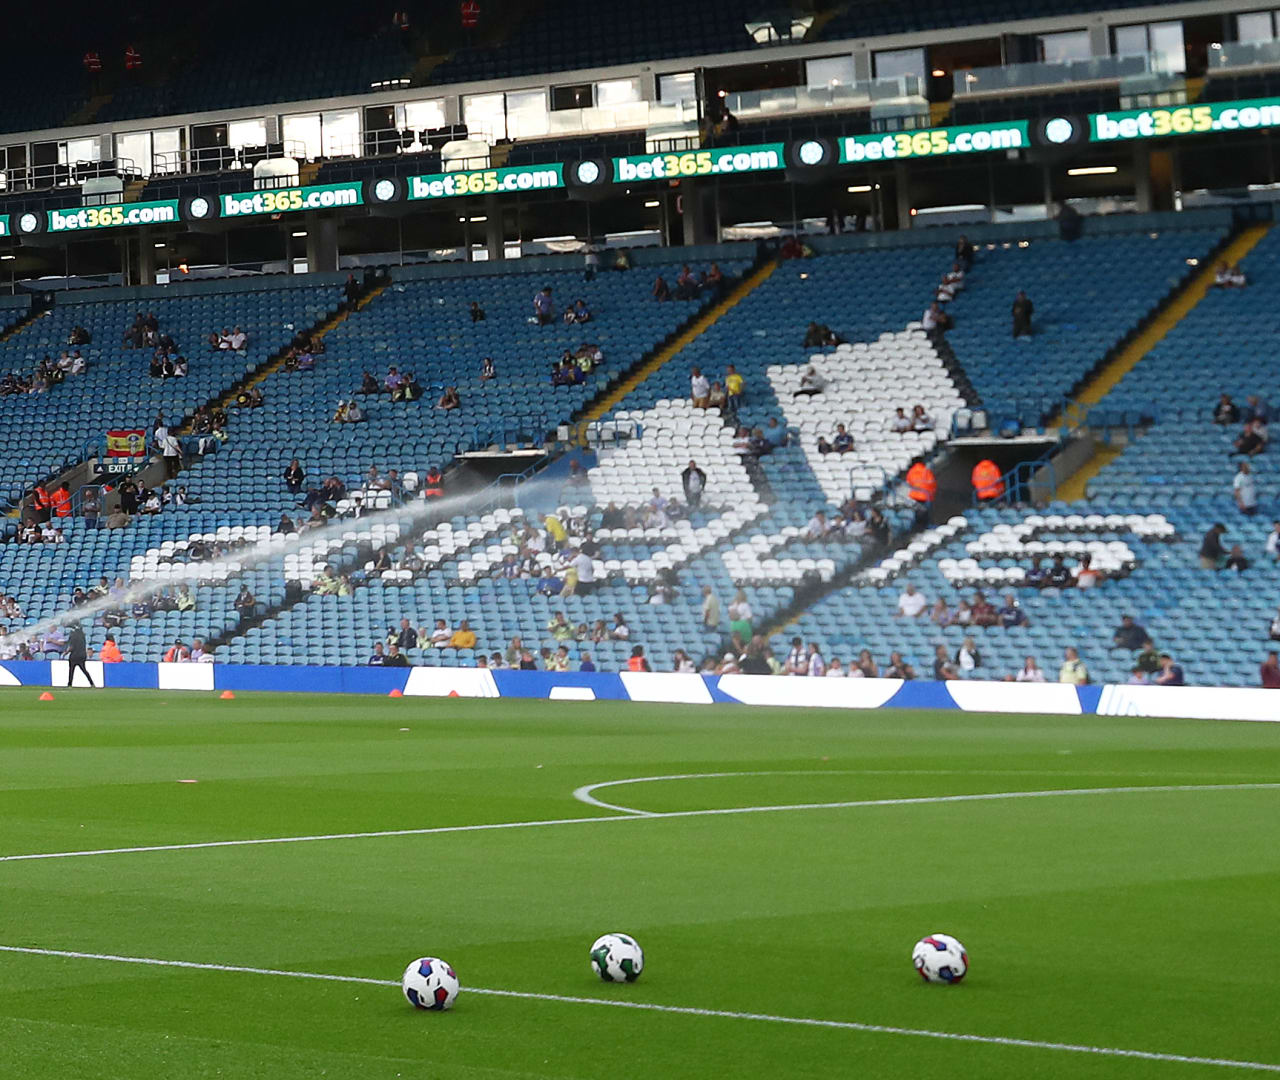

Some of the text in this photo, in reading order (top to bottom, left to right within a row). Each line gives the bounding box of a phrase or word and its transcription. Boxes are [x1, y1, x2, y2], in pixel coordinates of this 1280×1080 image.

[845, 126, 1022, 161] bet365.com
[619, 149, 778, 179] bet365.com
[413, 167, 557, 197] bet365.com
[225, 185, 357, 215] bet365.com
[52, 204, 173, 230] bet365.com
[108, 464, 126, 473] EXIT
